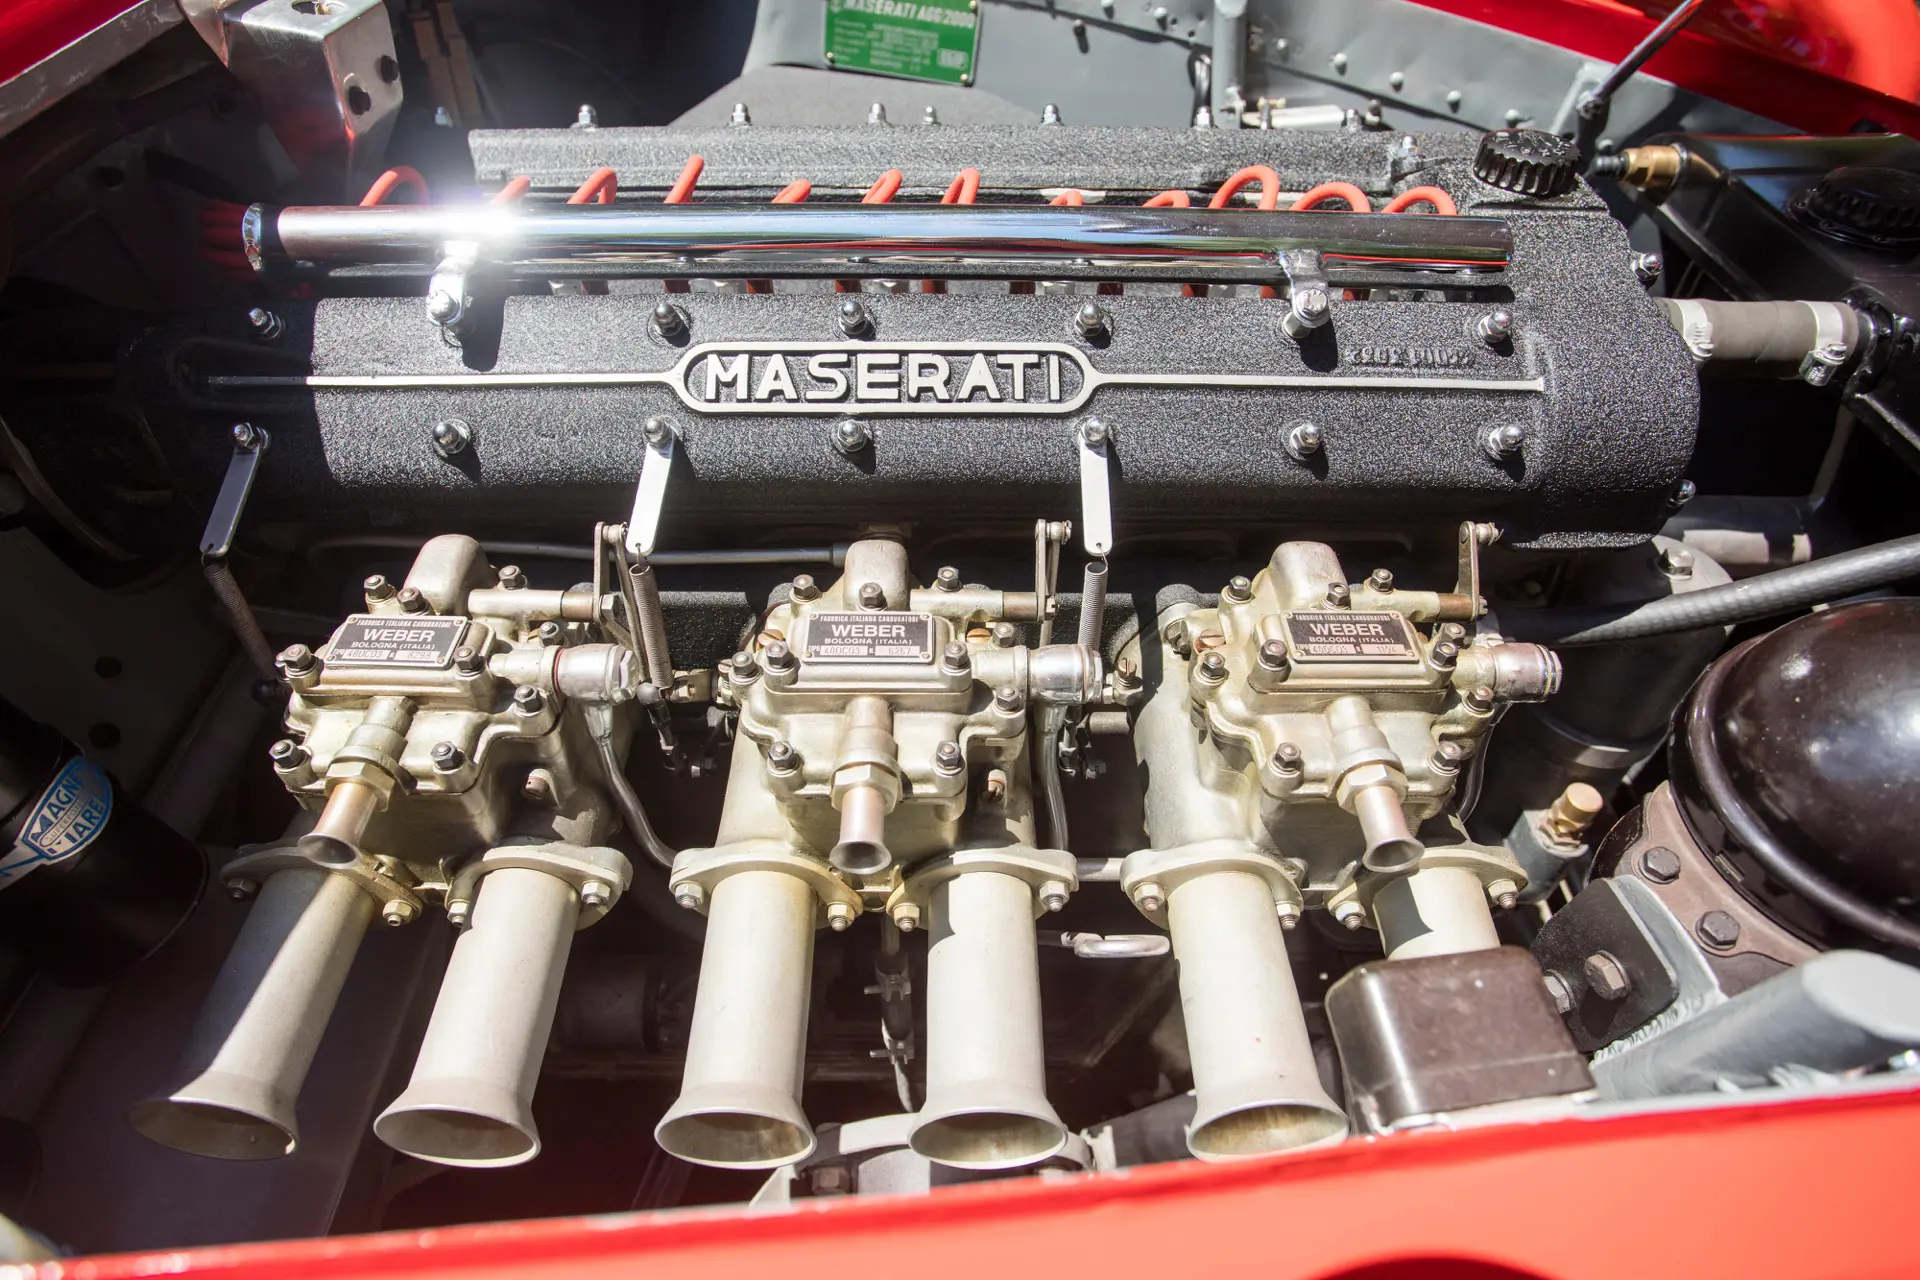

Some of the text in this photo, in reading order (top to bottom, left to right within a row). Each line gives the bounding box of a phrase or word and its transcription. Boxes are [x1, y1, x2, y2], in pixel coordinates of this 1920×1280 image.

[705, 353, 1060, 401] MASERATI
[385, 619, 412, 628] ITALIANA
[1309, 623, 1385, 636] WEBER
[363, 628, 435, 642] WEBER
[831, 624, 906, 637] WEBER
[350, 641, 435, 651] BOLOGNA (ITALIA)
